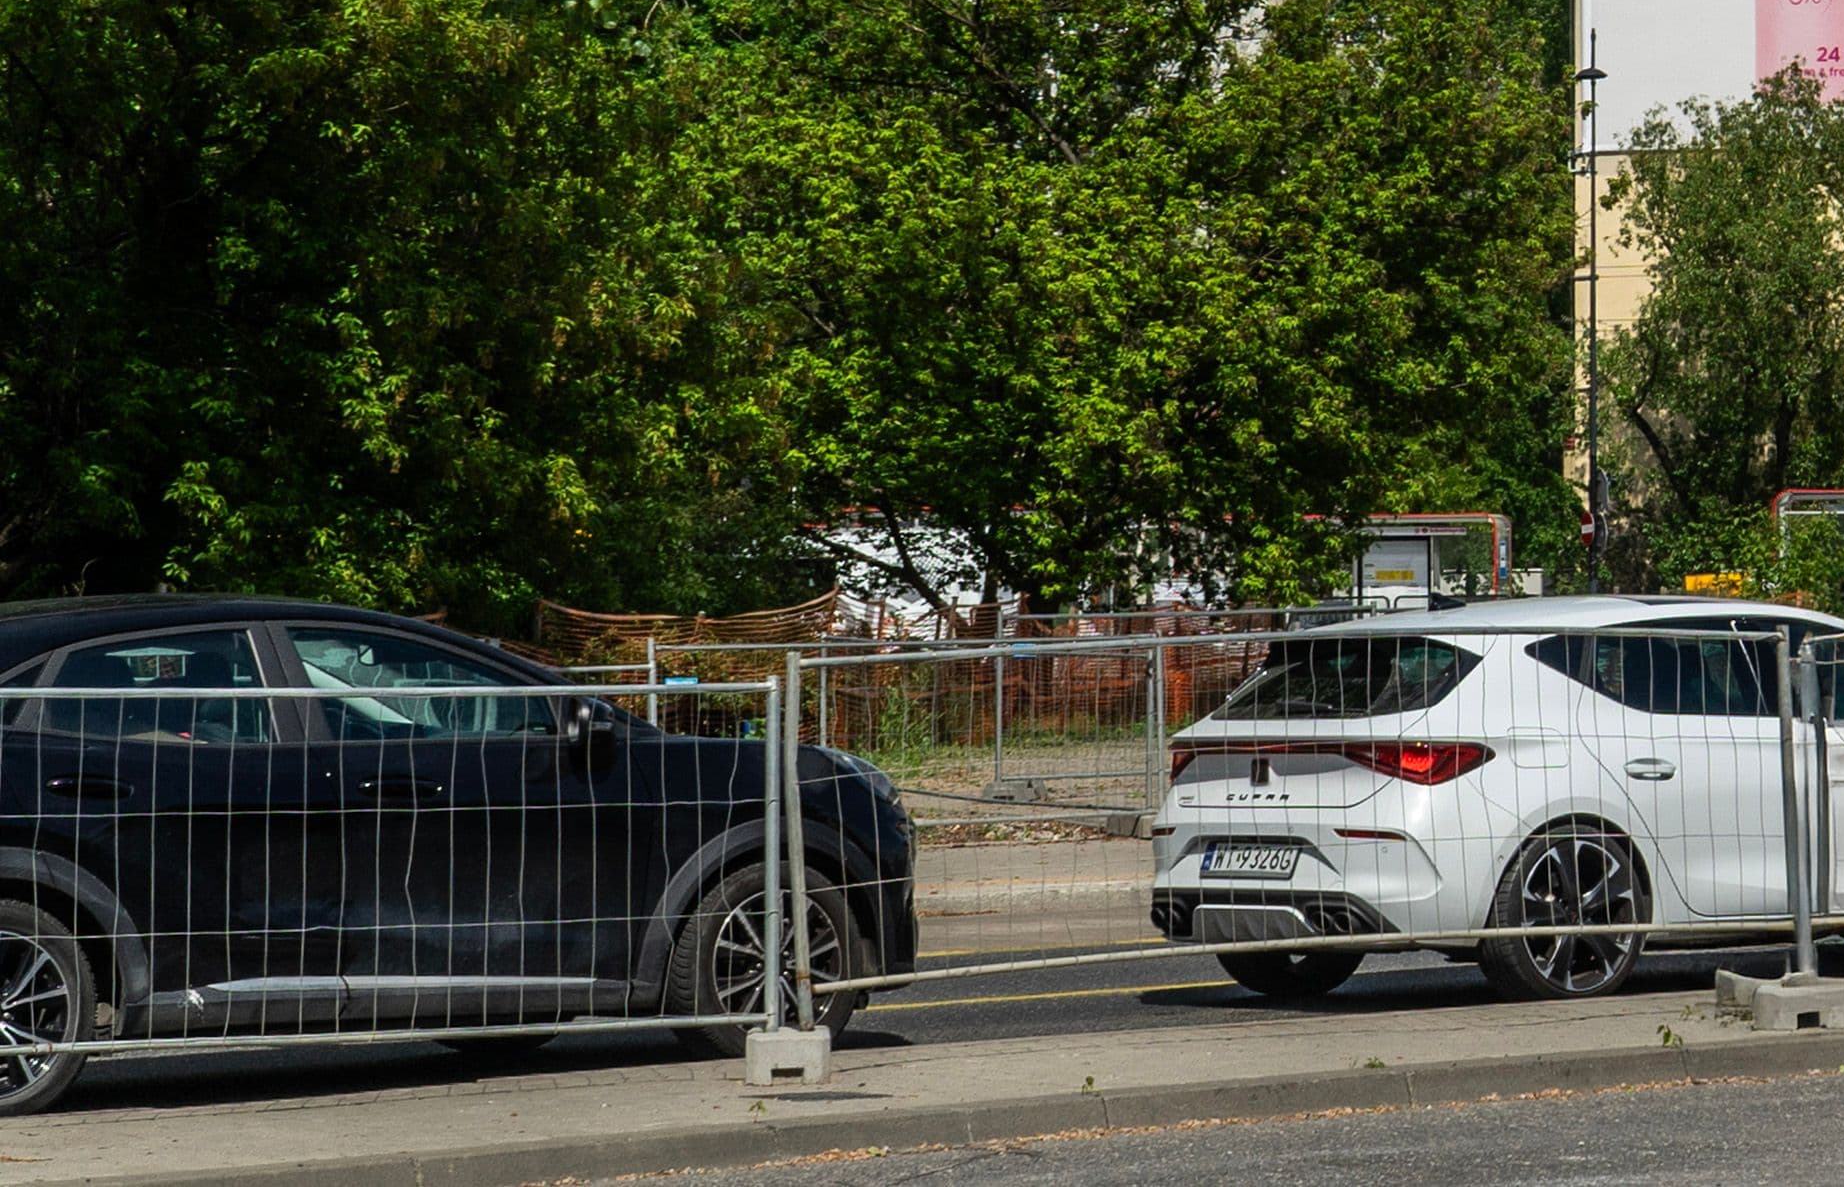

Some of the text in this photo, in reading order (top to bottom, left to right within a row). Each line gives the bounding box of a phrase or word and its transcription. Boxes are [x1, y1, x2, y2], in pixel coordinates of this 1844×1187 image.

[1816, 46, 1840, 62] 24
[1213, 845, 1294, 870] WT 9326G
